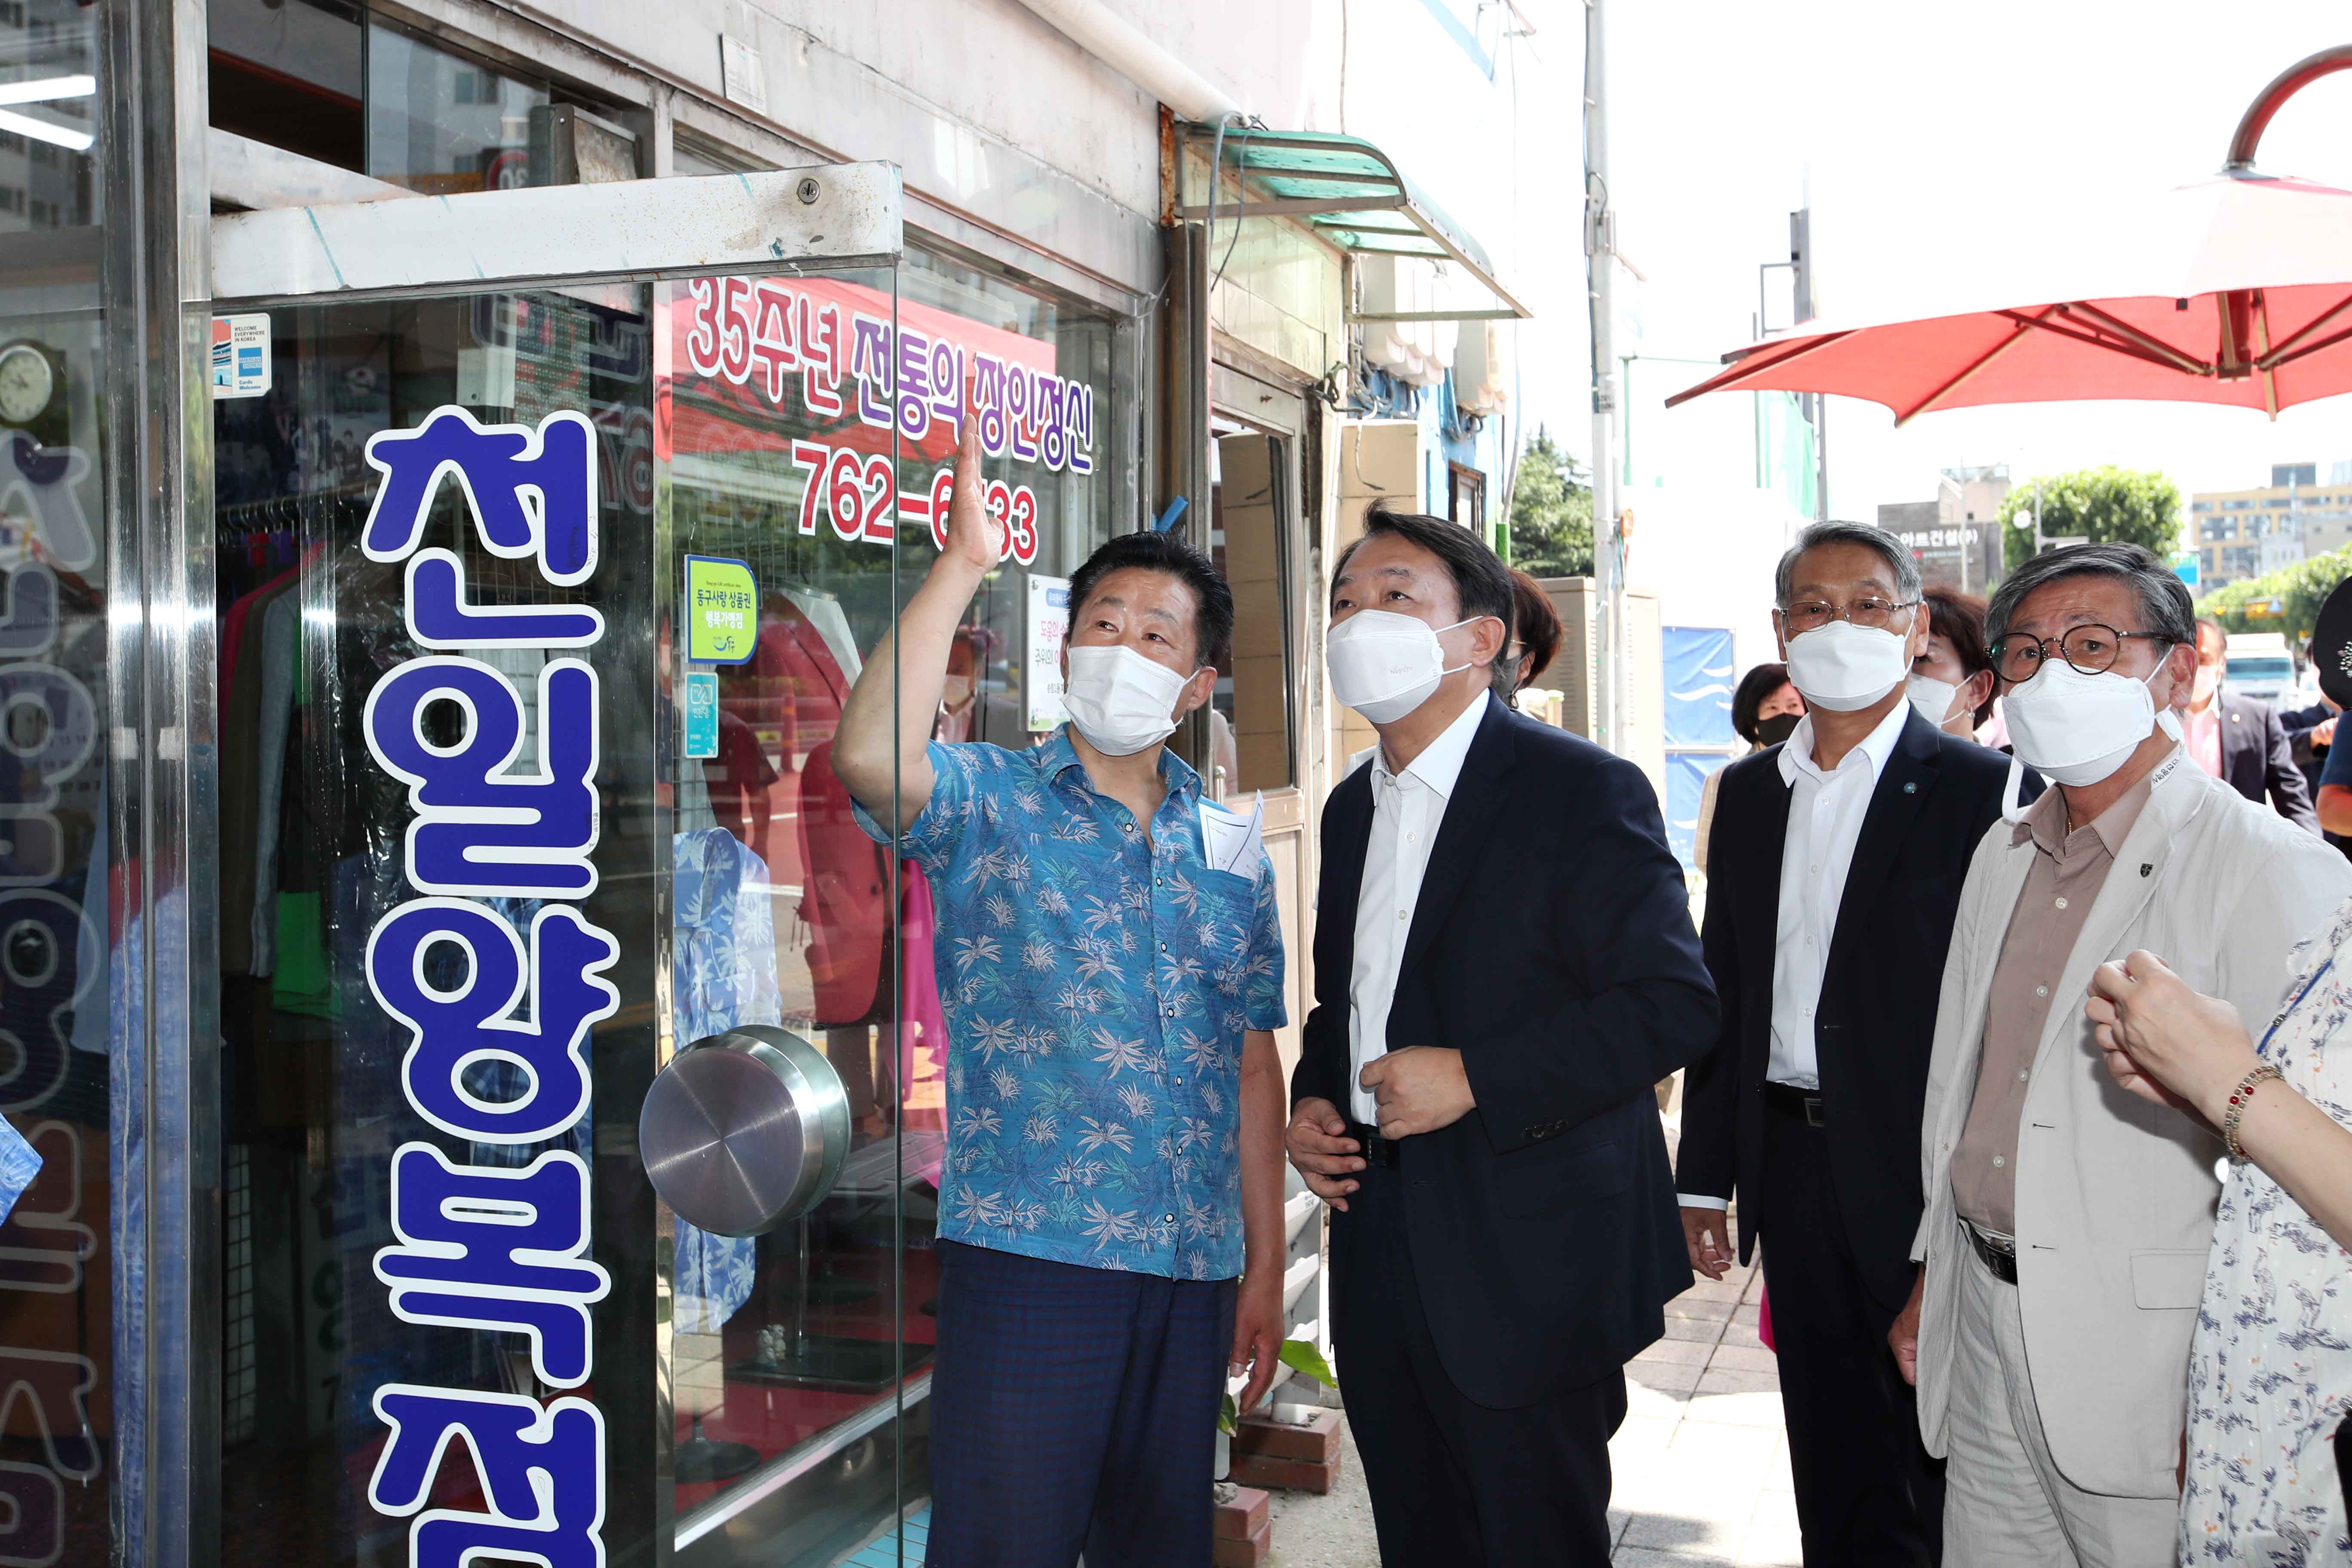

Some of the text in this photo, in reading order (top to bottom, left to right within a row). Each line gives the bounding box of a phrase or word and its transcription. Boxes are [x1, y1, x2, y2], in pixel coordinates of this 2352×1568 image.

[688, 276, 842, 417] 35주년
[851, 311, 965, 445] 전통의
[973, 352, 1093, 475] 장인정신
[792, 438, 1038, 566] 762-633
[697, 589, 750, 609] 동구사랑 상품권
